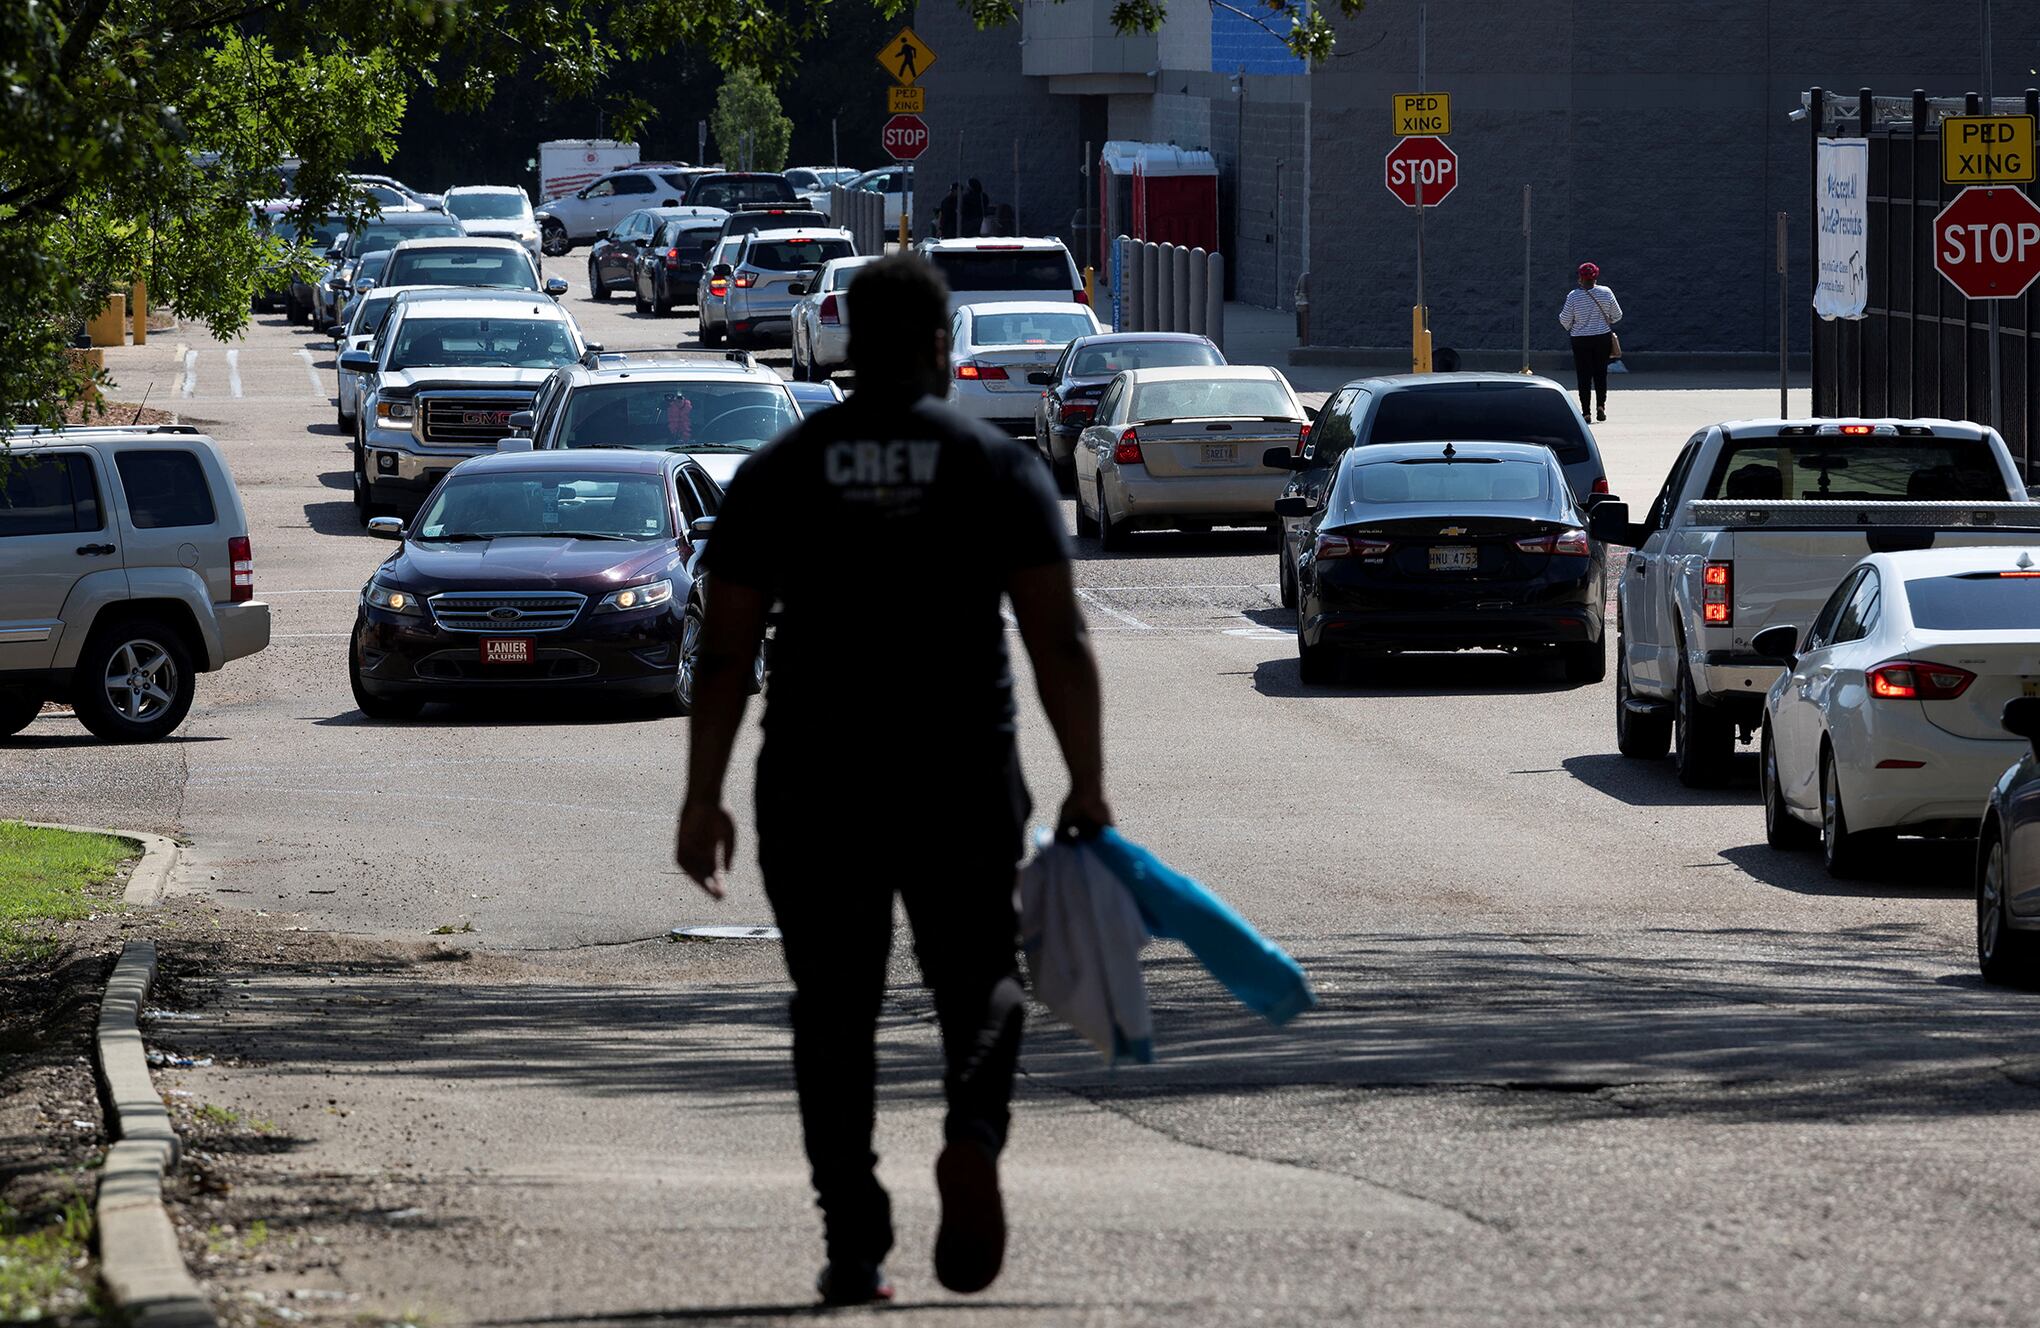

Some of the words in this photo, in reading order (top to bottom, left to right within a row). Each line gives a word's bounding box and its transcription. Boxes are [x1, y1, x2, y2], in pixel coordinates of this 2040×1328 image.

[895, 88, 918, 98] PED
[893, 101, 919, 111] XING
[1405, 97, 1438, 111] PED
[1403, 116, 1442, 130] XING
[885, 128, 926, 146] STOP
[1962, 123, 2015, 144] PED
[1958, 153, 2021, 175] XING
[1391, 158, 1453, 185] STOP
[1943, 222, 2040, 265] STOP
[463, 411, 511, 425] GMC
[824, 440, 941, 486] CREW
[487, 641, 527, 654] LANIER
[487, 653, 528, 662] ALUMNI
